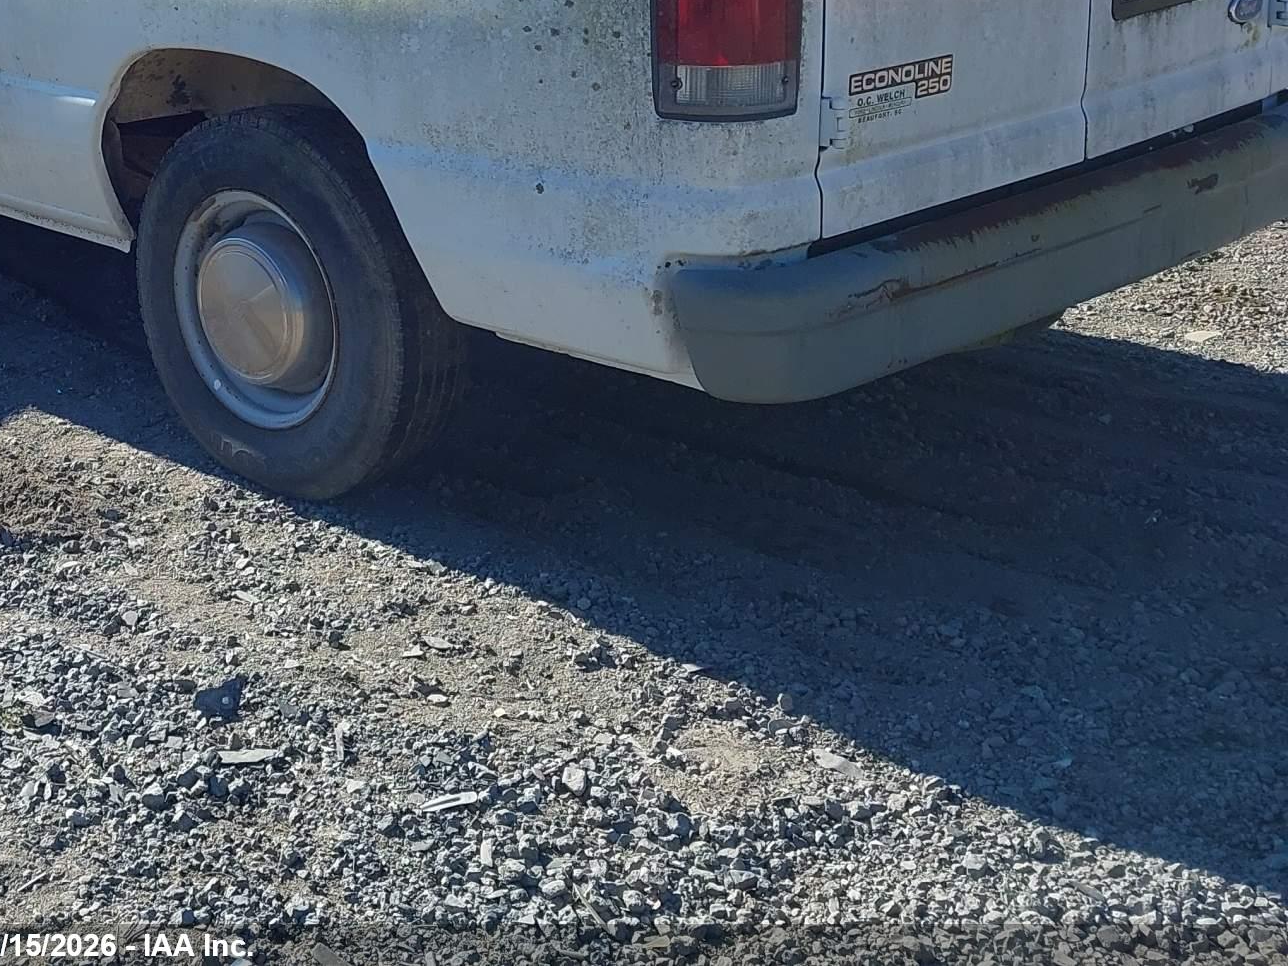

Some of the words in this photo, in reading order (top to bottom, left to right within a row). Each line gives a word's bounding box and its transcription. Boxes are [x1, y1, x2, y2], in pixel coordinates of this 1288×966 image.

[850, 57, 952, 93] ECONOLINE
[917, 75, 951, 96] 250
[876, 89, 905, 103] WELCH
